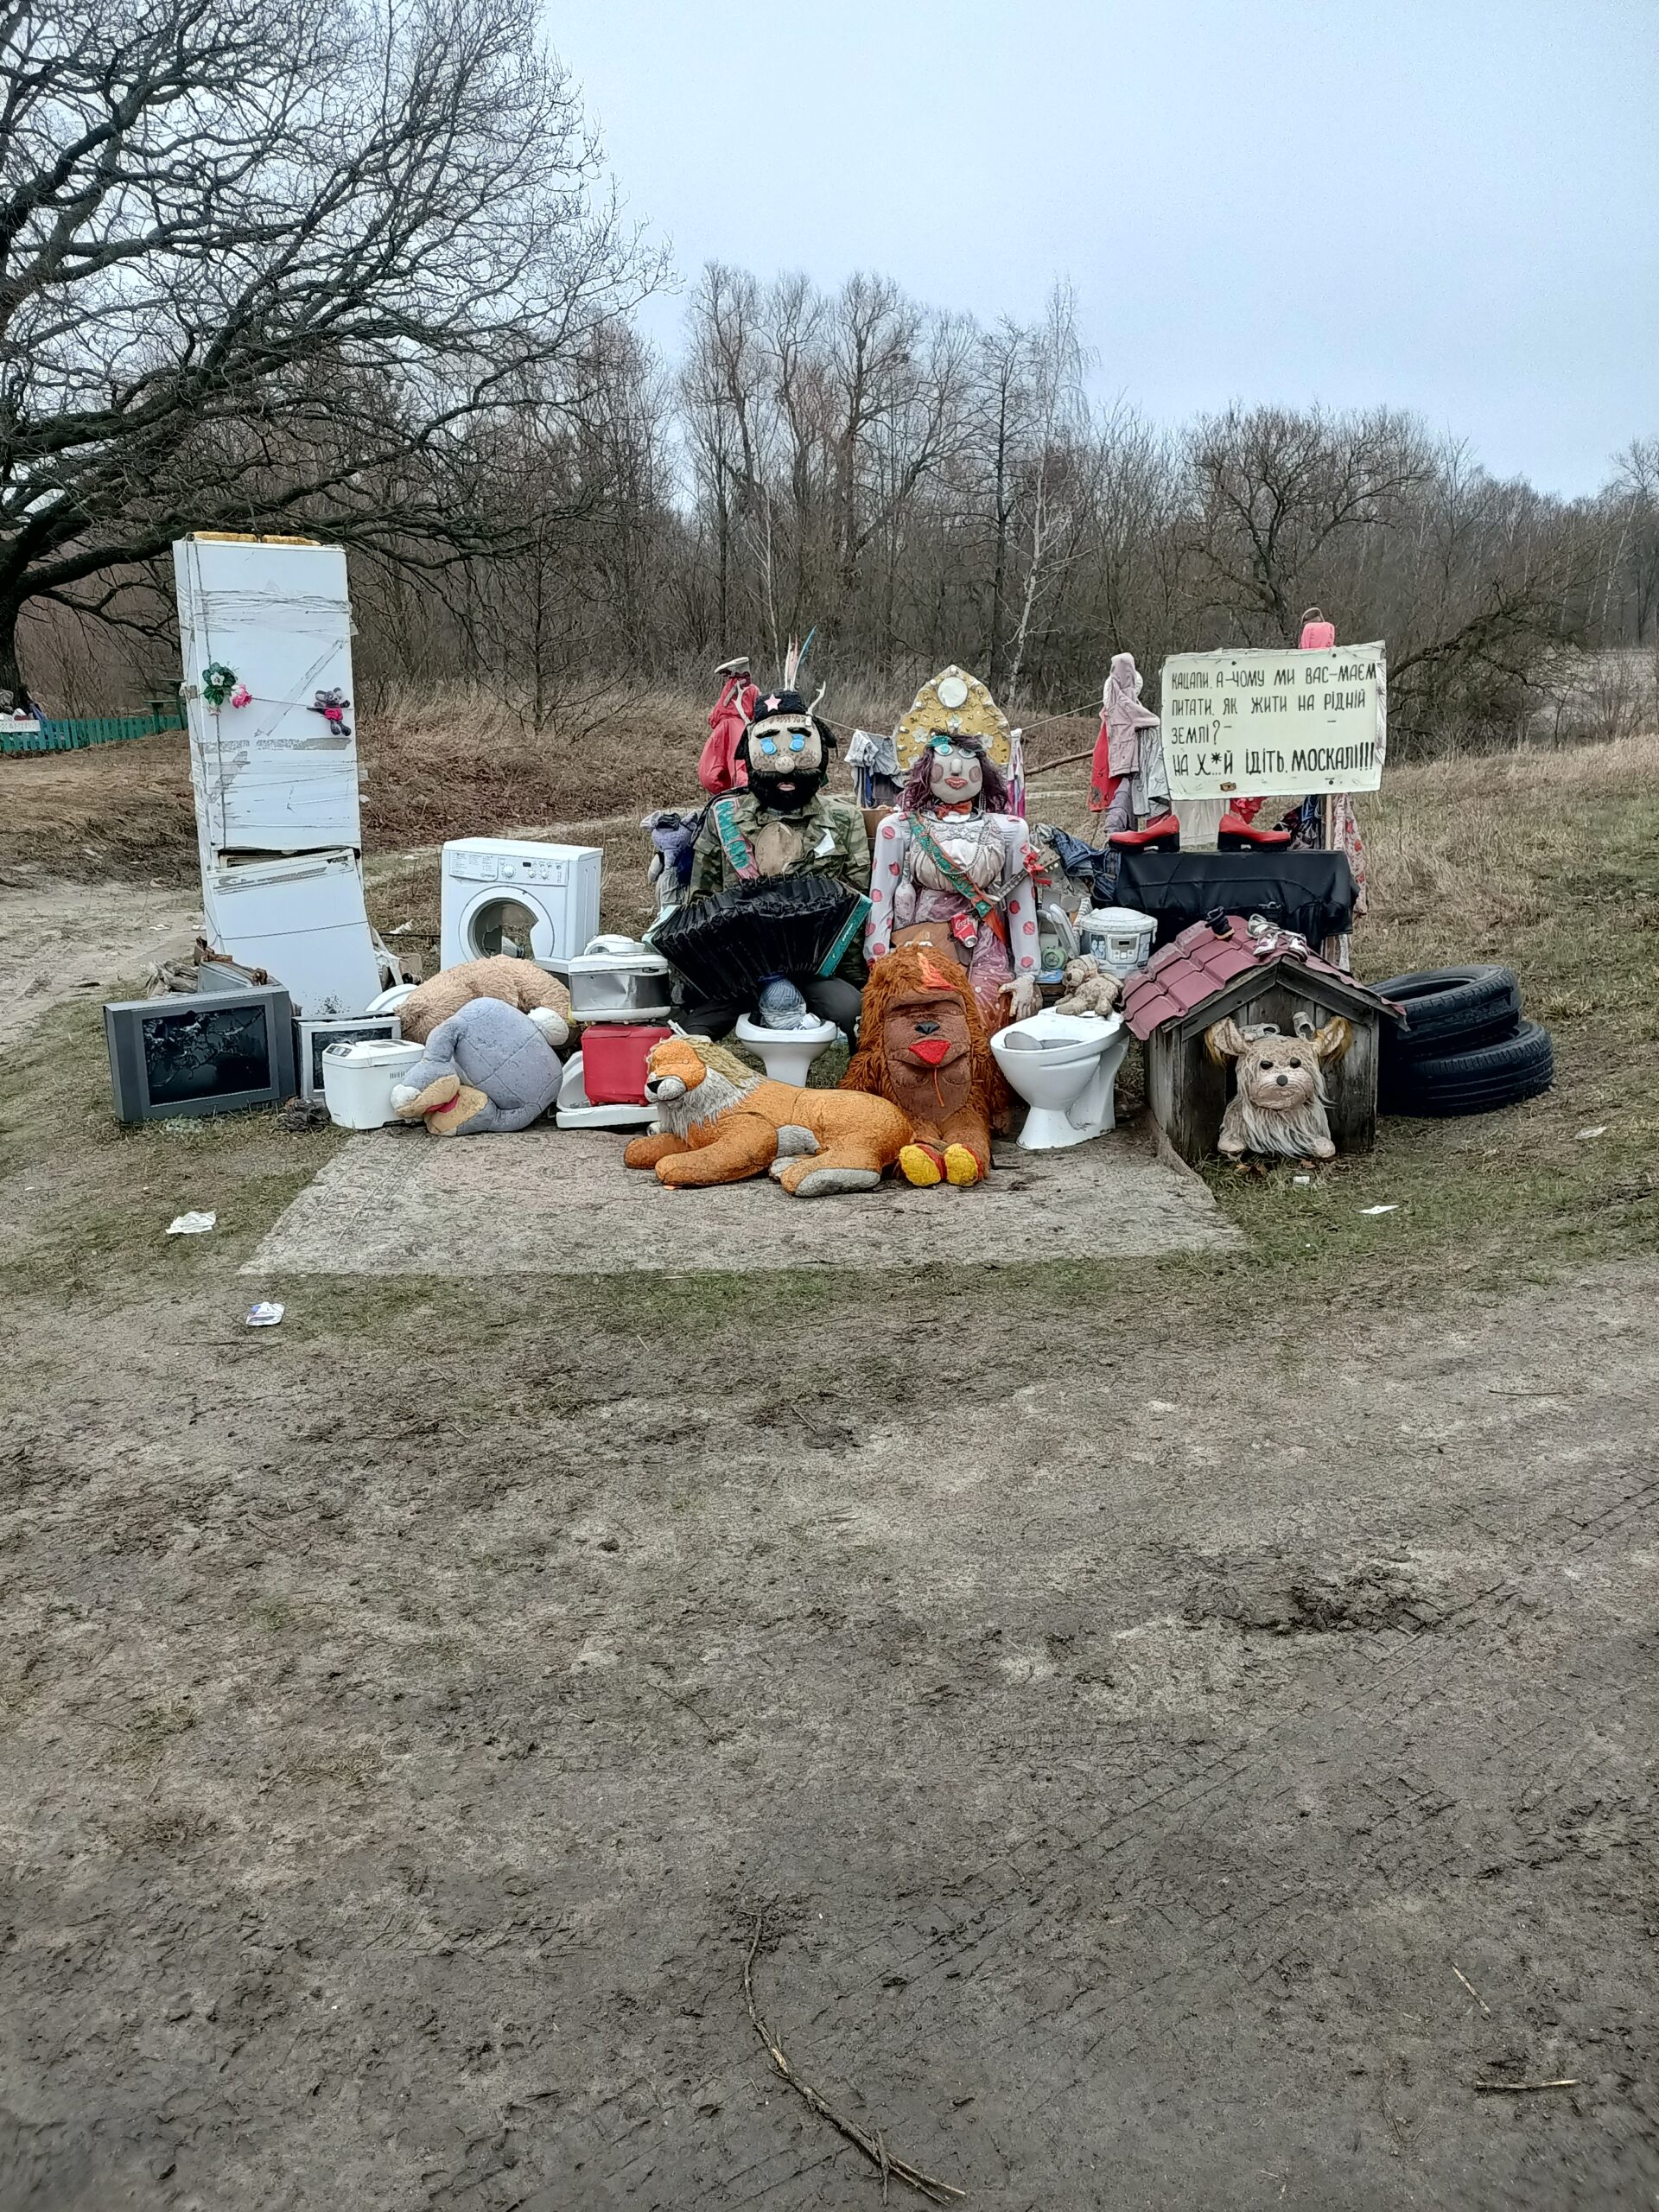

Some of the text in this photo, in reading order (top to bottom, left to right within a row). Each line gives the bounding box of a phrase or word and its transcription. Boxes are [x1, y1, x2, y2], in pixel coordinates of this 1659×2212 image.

[1274, 668, 1294, 686] МИ
[1223, 697, 1237, 715] ЯК
[1251, 696, 1287, 714] ЖИТИ
[1298, 694, 1314, 711] НА
[1324, 689, 1365, 711] РІДНІЙ
[1173, 753, 1189, 776] НА
[1291, 741, 1375, 772] МОСКАЛІ!!!
